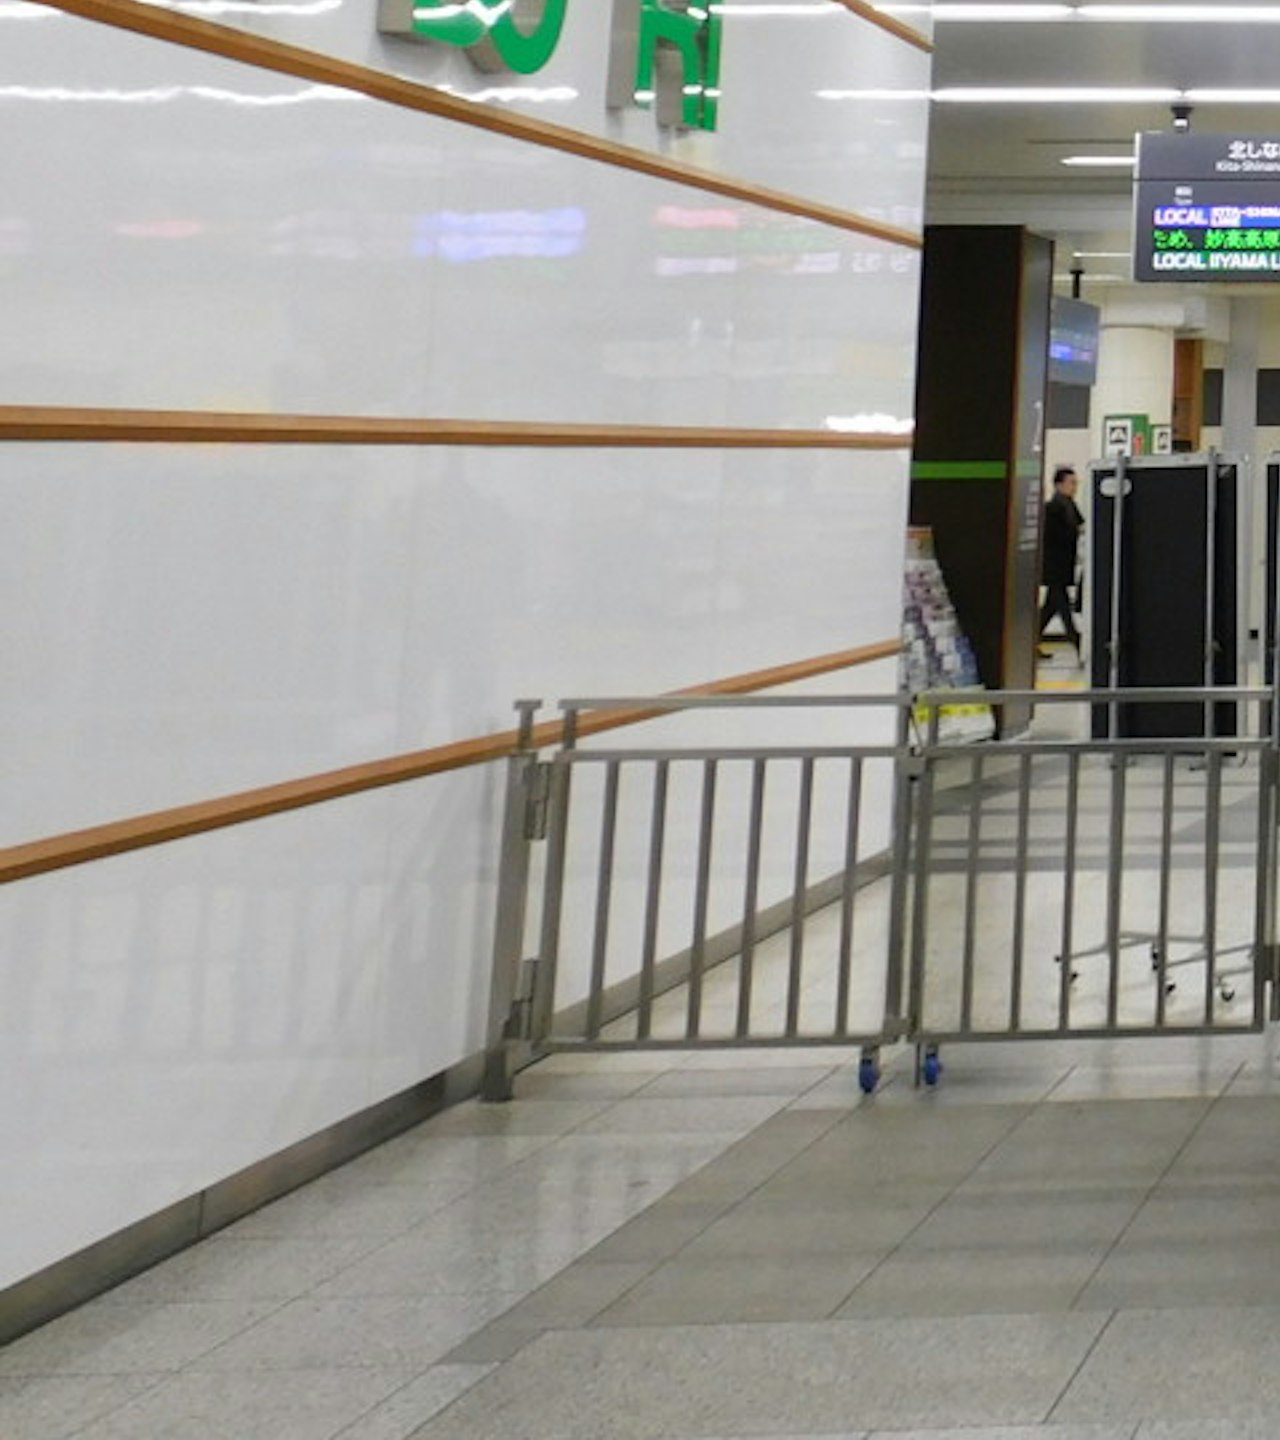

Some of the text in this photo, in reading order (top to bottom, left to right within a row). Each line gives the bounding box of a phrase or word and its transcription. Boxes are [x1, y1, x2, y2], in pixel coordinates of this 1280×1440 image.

[1154, 208, 1208, 227] LOCAL
[1153, 251, 1206, 270] LOCAL
[1209, 251, 1270, 270] IIYAMA
